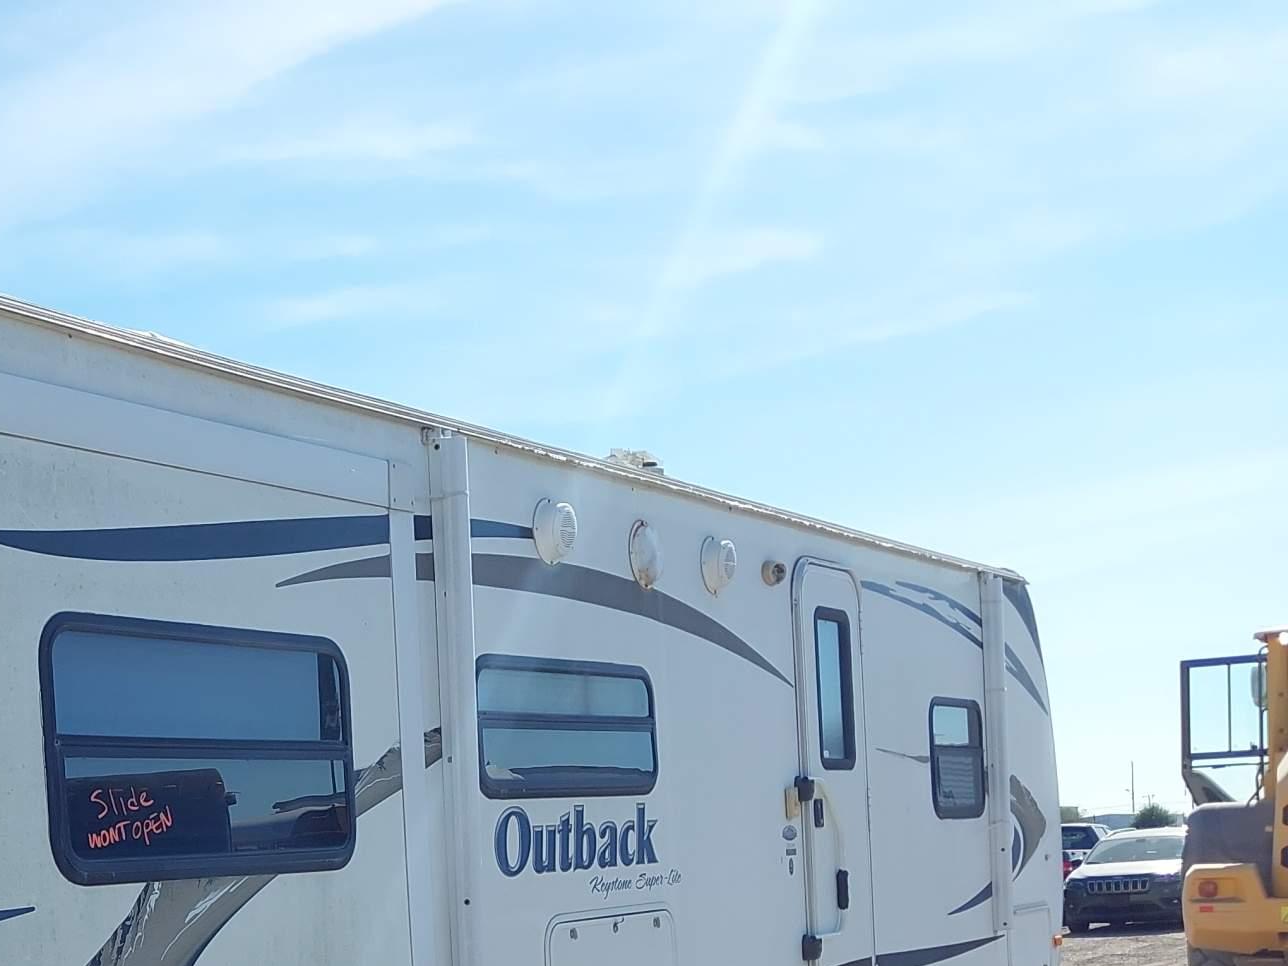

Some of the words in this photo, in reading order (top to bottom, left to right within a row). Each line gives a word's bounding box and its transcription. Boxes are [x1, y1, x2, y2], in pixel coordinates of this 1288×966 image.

[90, 786, 154, 819] Slide
[88, 820, 131, 849] WONT
[132, 805, 173, 846] OPEN
[494, 802, 659, 878] Outback
[589, 875, 632, 900] Keystone
[635, 868, 682, 892] Super-Lite
